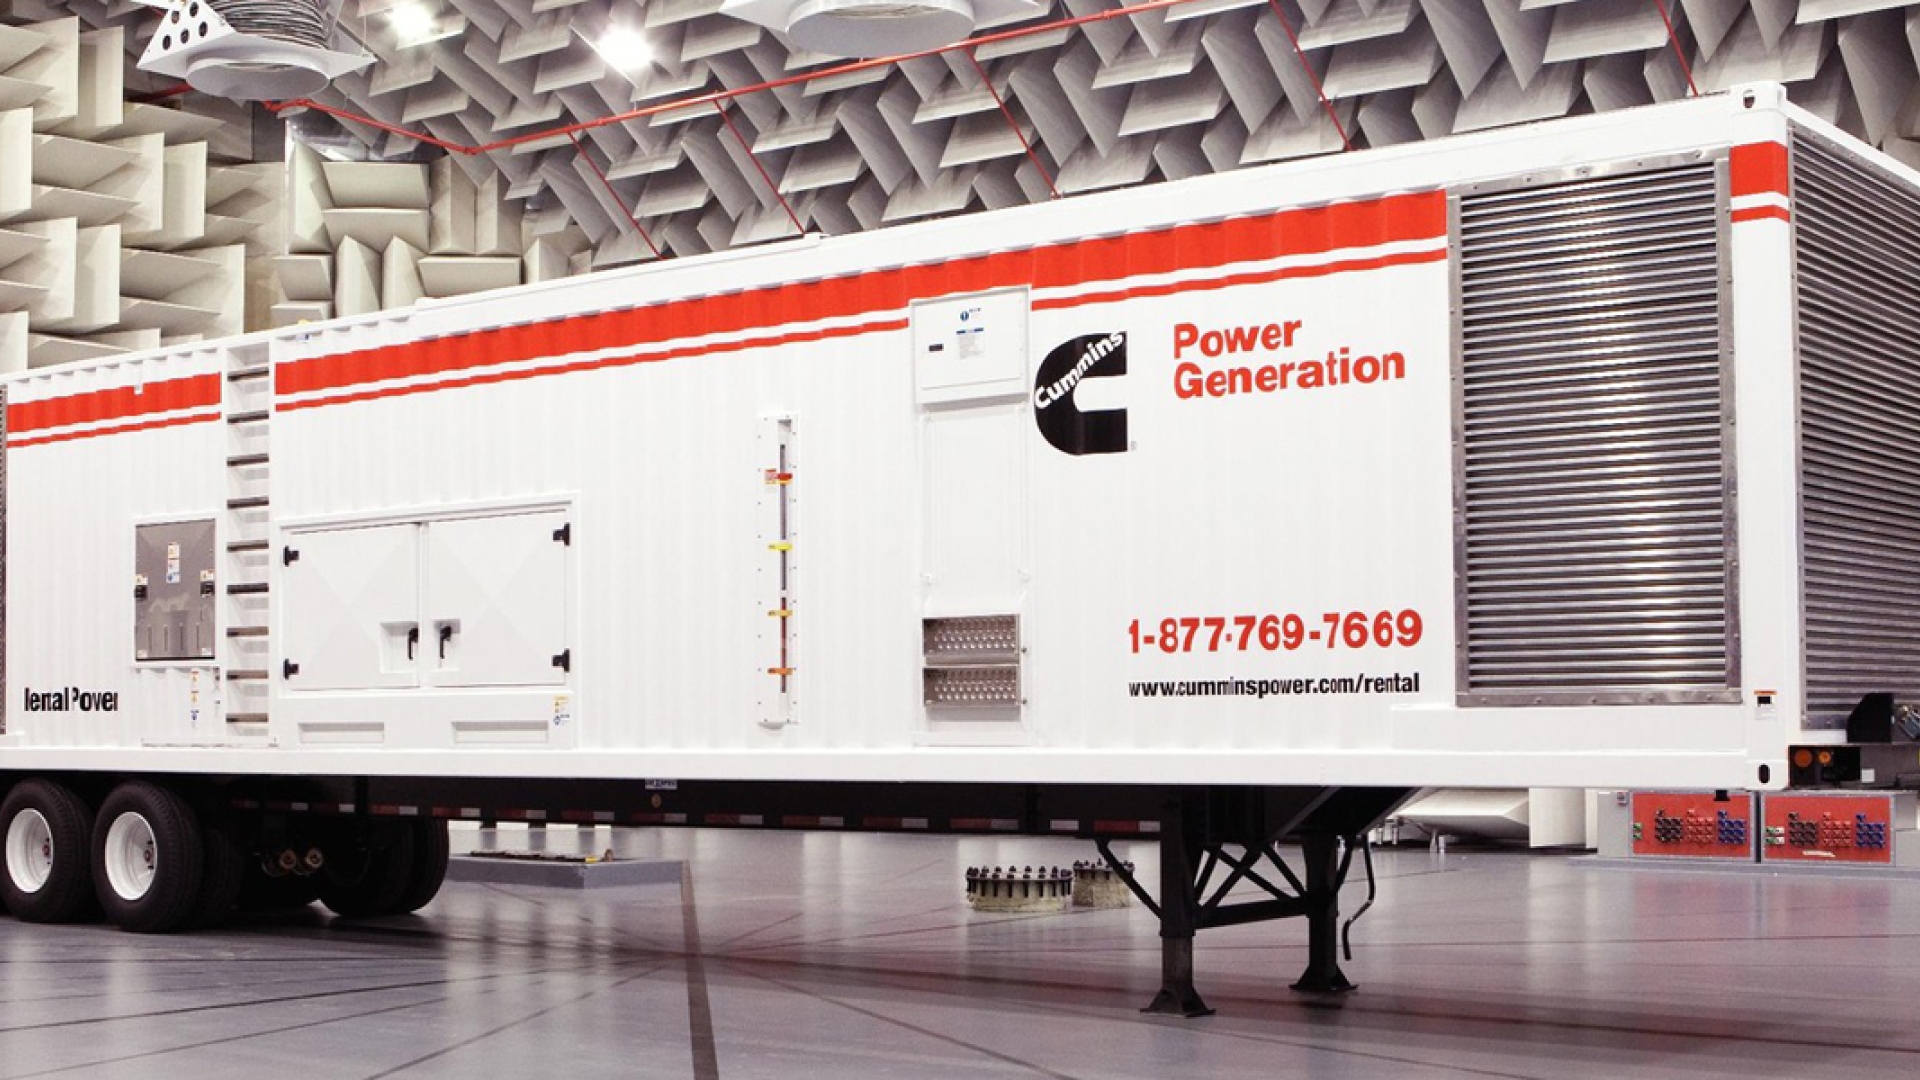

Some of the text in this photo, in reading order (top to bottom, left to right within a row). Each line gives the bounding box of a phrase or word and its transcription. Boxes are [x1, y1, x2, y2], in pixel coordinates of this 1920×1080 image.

[1174, 319, 1302, 359] Power
[1034, 331, 1124, 410] Cummins
[1173, 346, 1405, 400] Generation
[1128, 672, 1420, 698] www.cumminspower.com/rental
